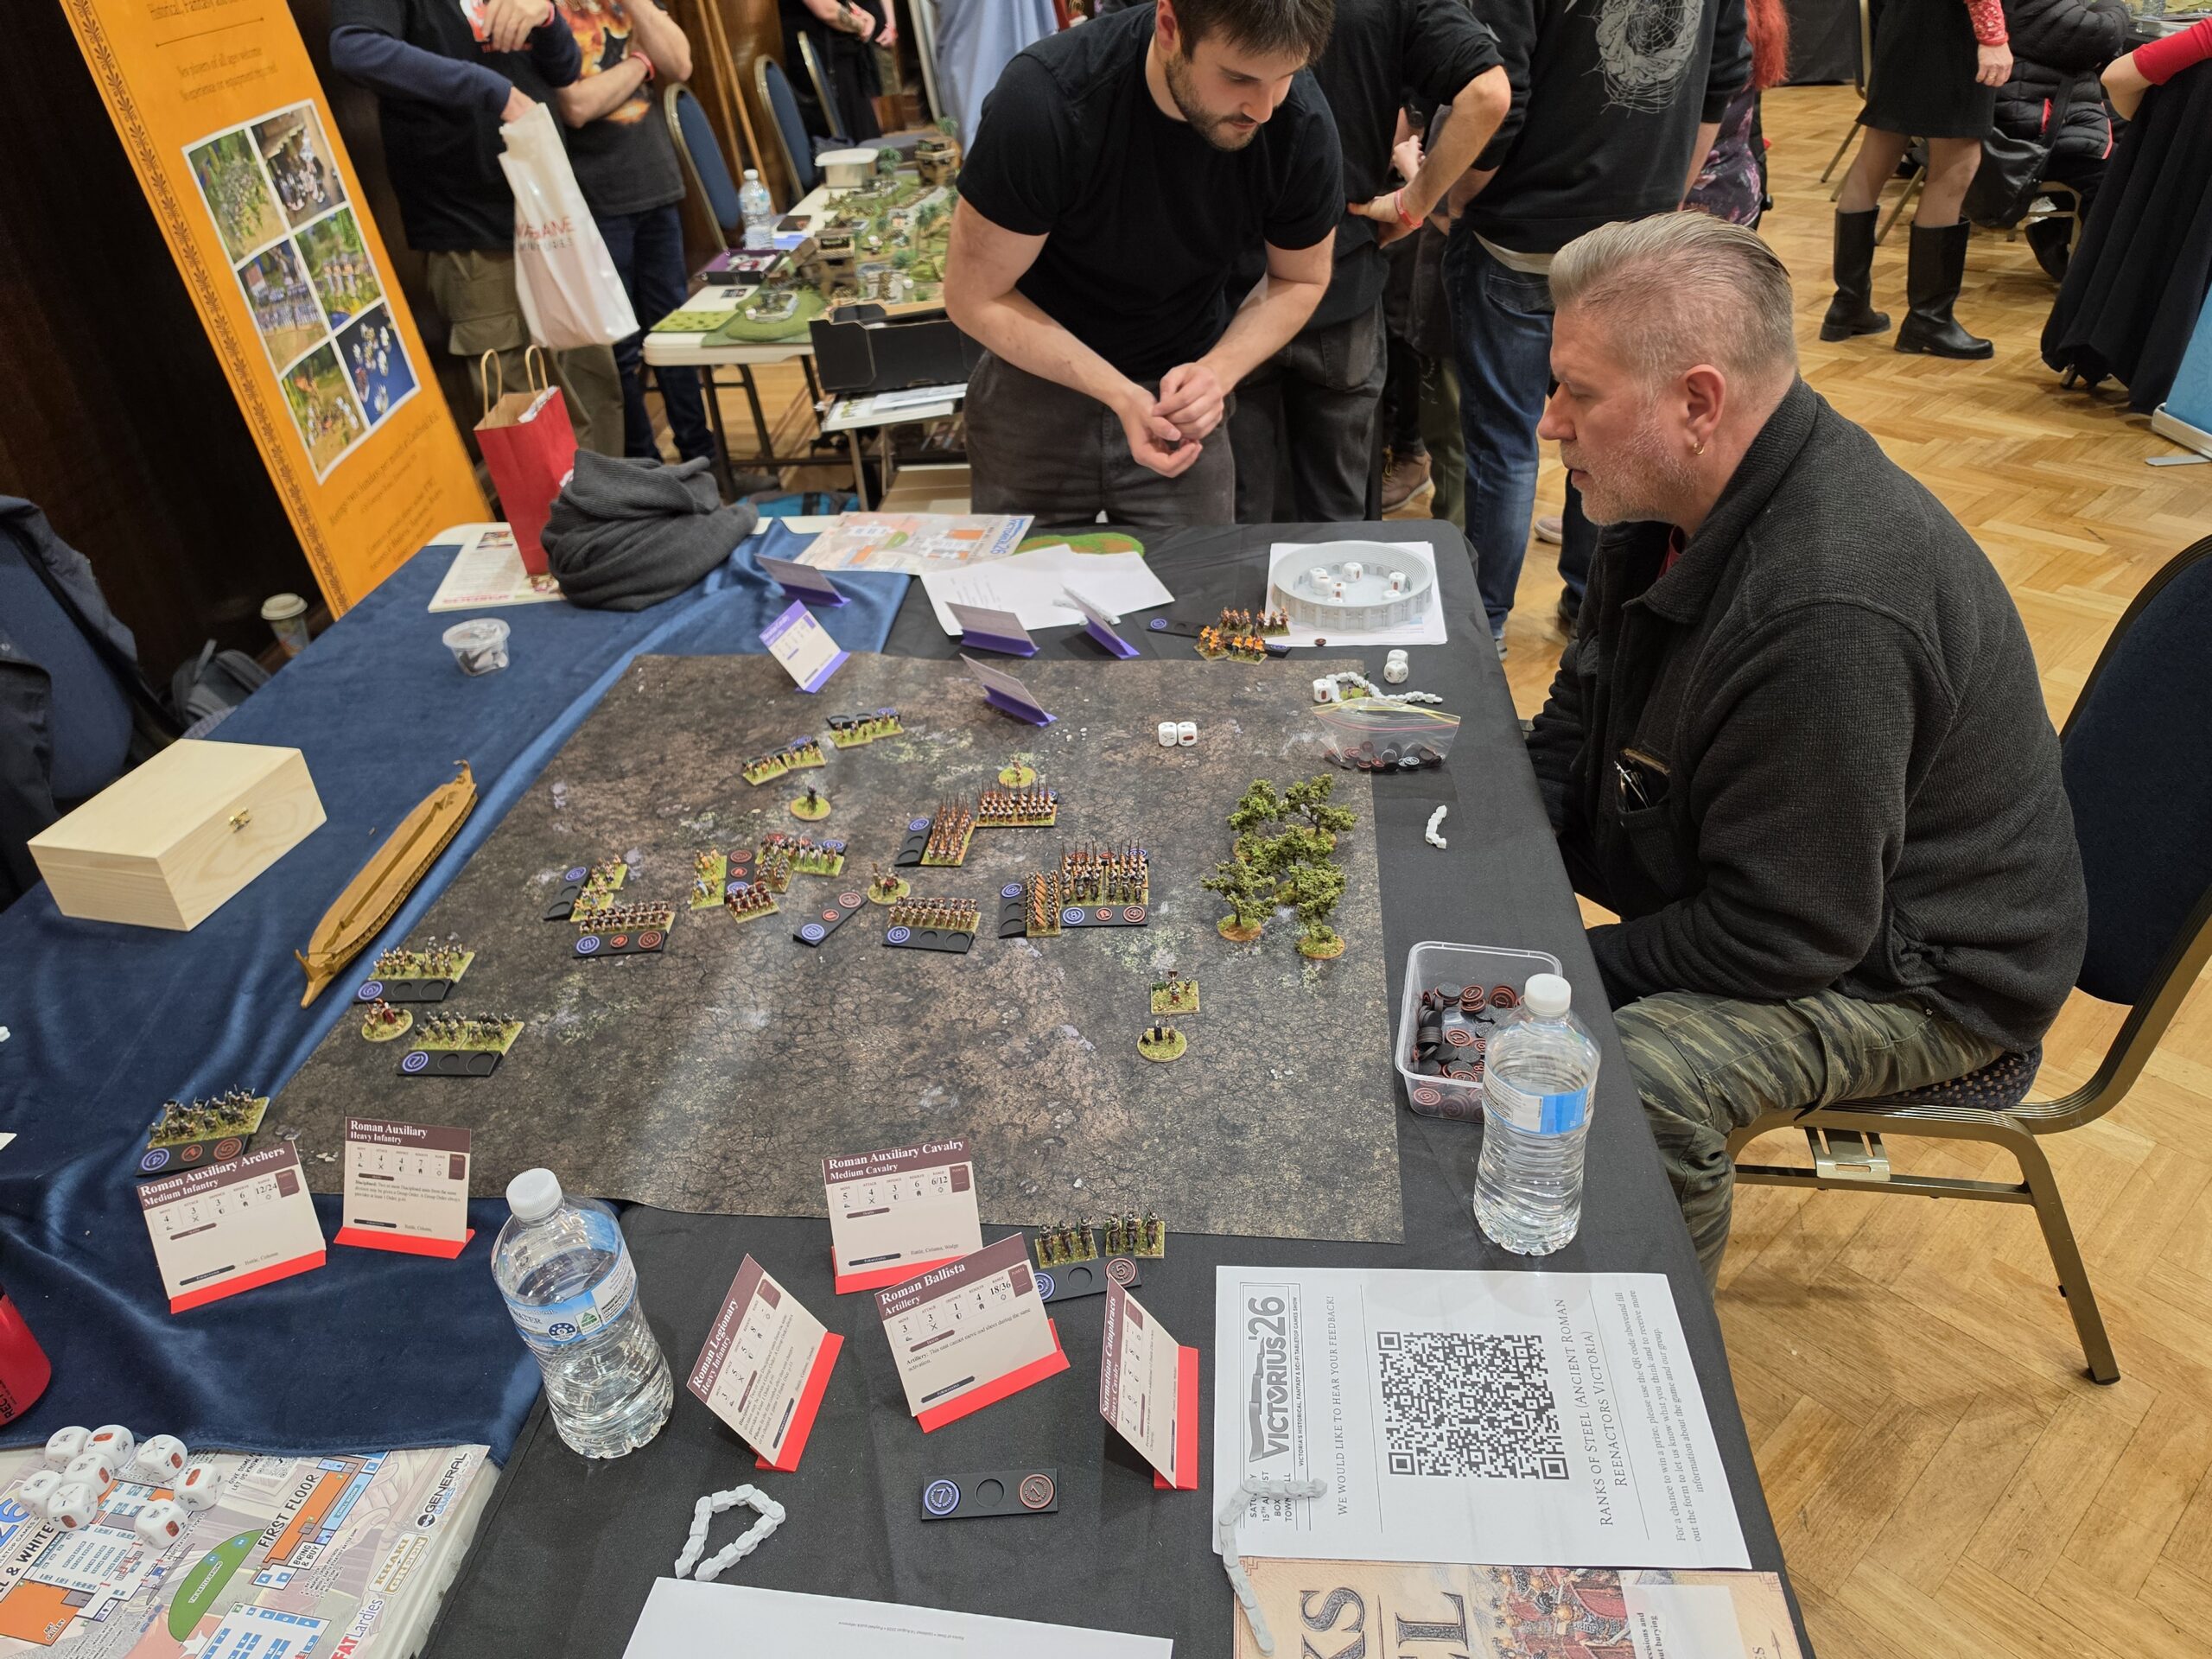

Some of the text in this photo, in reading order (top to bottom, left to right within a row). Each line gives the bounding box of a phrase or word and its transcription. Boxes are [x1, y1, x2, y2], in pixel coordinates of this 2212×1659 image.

[351, 1120, 428, 1139] Roman Auxiliary
[351, 1131, 402, 1145] Heavy Infantry
[829, 1140, 964, 1170] Roman Auxiliary Cavalry
[140, 1147, 285, 1197] Roman Auxiliary Archers
[830, 1164, 898, 1180] Medium Cavalry
[931, 1175, 948, 1185] 6/12
[143, 1179, 219, 1206] Medium Infantry
[255, 1182, 277, 1195] 12/24
[880, 1264, 965, 1305] Roman Ballista
[920, 1275, 1004, 1313] ATTACK RANGE
[886, 1295, 920, 1316] Artillery
[900, 1324, 908, 1333] 3
[926, 1313, 934, 1323] 3
[975, 1293, 982, 1301] 4
[988, 1281, 1012, 1295] 18/36
[1614, 1292, 1625, 1302] fill
[1630, 1290, 1640, 1308] more
[1618, 1303, 1634, 1337] aboveand
[1635, 1310, 1647, 1335] receive
[692, 1298, 738, 1389] Roman Legionary
[905, 1350, 929, 1366] Artillery:
[929, 1345, 939, 1356] This
[938, 1342, 949, 1351] unit
[948, 1335, 964, 1348] cannot
[963, 1330, 977, 1341] move
[976, 1325, 986, 1336] and
[985, 1321, 998, 1332] shoot
[996, 1314, 1013, 1327] during
[1019, 1306, 1032, 1318] same
[1627, 1338, 1638, 1356] code
[701, 1332, 731, 1395] Heavy Infantry
[1102, 1296, 1116, 1415] Sarmatian Cataphracts
[1631, 1357, 1643, 1370] QR
[1643, 1347, 1654, 1361] and
[730, 1368, 739, 1376] 5
[1247, 1295, 1289, 1459] VICTORIUS '26
[1637, 1370, 1646, 1383] the
[1647, 1363, 1660, 1383] think
[1641, 1384, 1649, 1398] use
[1655, 1386, 1667, 1401] you
[1326, 1296, 1348, 1516] WE WOULD LIKE TO HEAR YOUR FEEDBACK!
[1554, 1300, 1613, 1526] RANKS OF STEEL (ANCIENT ROMAN
[1581, 1332, 1628, 1486] REENACTORS VICTORIA)
[1644, 1400, 1659, 1424] please
[1654, 1327, 1704, 1492] information about the game and our group.
[1659, 1402, 1670, 1422] what
[1651, 1426, 1665, 1449] prize,
[1665, 1424, 1677, 1446] know
[1659, 1458, 1669, 1473] win
[1672, 1449, 1680, 1459] us
[227, 1457, 251, 1484] GIVE SOME
[231, 1457, 260, 1491] LET US KNOW
[1675, 1461, 1684, 1471] let
[425, 1452, 467, 1513] GENERAL
[1664, 1475, 1672, 1484] to
[1678, 1474, 1687, 1483] to
[435, 1484, 455, 1515] GAMES
[1666, 1485, 1680, 1516] chance
[1681, 1485, 1693, 1507] form
[257, 1471, 320, 1549] FIRST FLOOR
[1261, 1506, 1269, 1522] 15TH
[1687, 1510, 1697, 1524] the
[15, 1519, 35, 1543] GAMES
[1675, 1525, 1686, 1541] For
[1691, 1527, 1701, 1542] out
[166, 1530, 191, 1560] REGISTRATION
[292, 1542, 312, 1567] BRING
[301, 1544, 319, 1567] & BUY
[7, 1564, 22, 1578] &
[374, 1535, 410, 1586] KHAKI
[390, 1536, 426, 1590] GREEN
[43, 1622, 54, 1634] ART
[46, 1618, 66, 1641] GALLERY
[1637, 1612, 1647, 1628] and
[1650, 1615, 1662, 1647] burying
